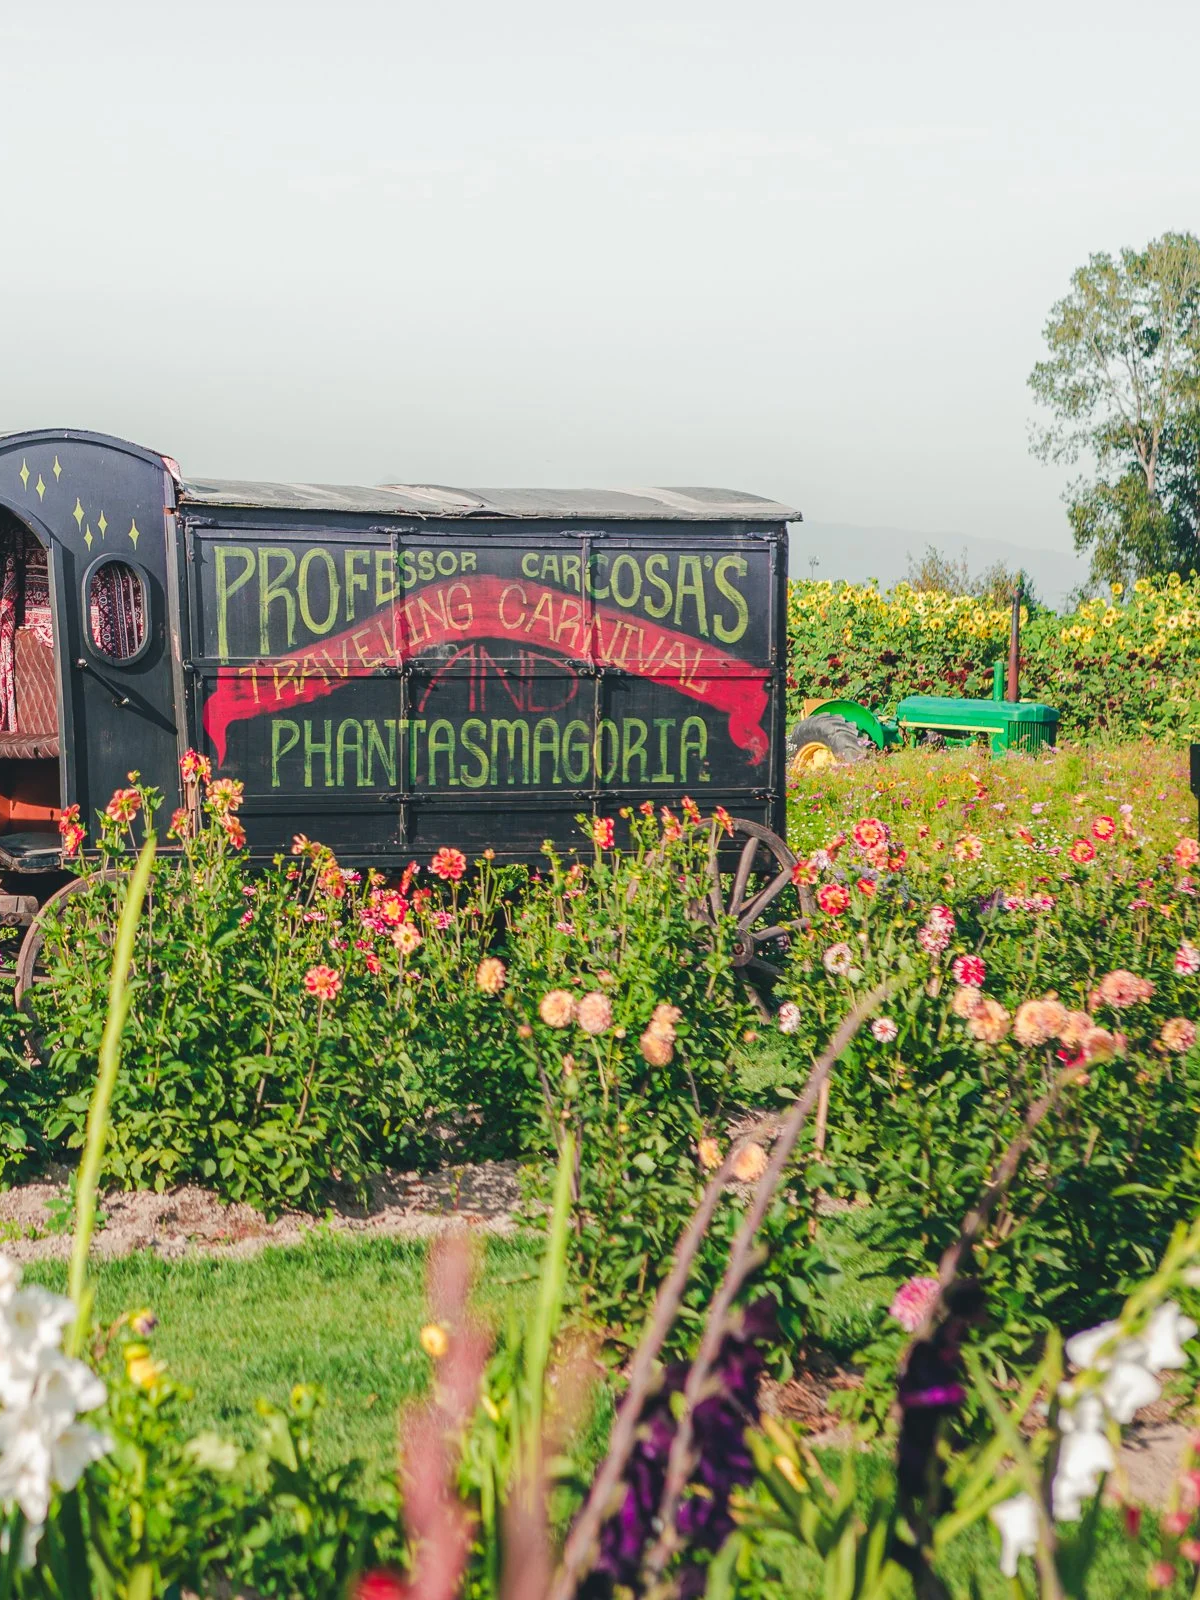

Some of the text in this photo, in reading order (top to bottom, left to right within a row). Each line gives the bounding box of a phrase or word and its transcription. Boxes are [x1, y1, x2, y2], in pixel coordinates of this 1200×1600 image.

[214, 545, 749, 665] PROFESSOR CARCOSA'S
[238, 582, 712, 704] TRAVELING CARNIVAL
[418, 643, 580, 713] AND
[271, 716, 711, 788] PHANTASMAGORIA
